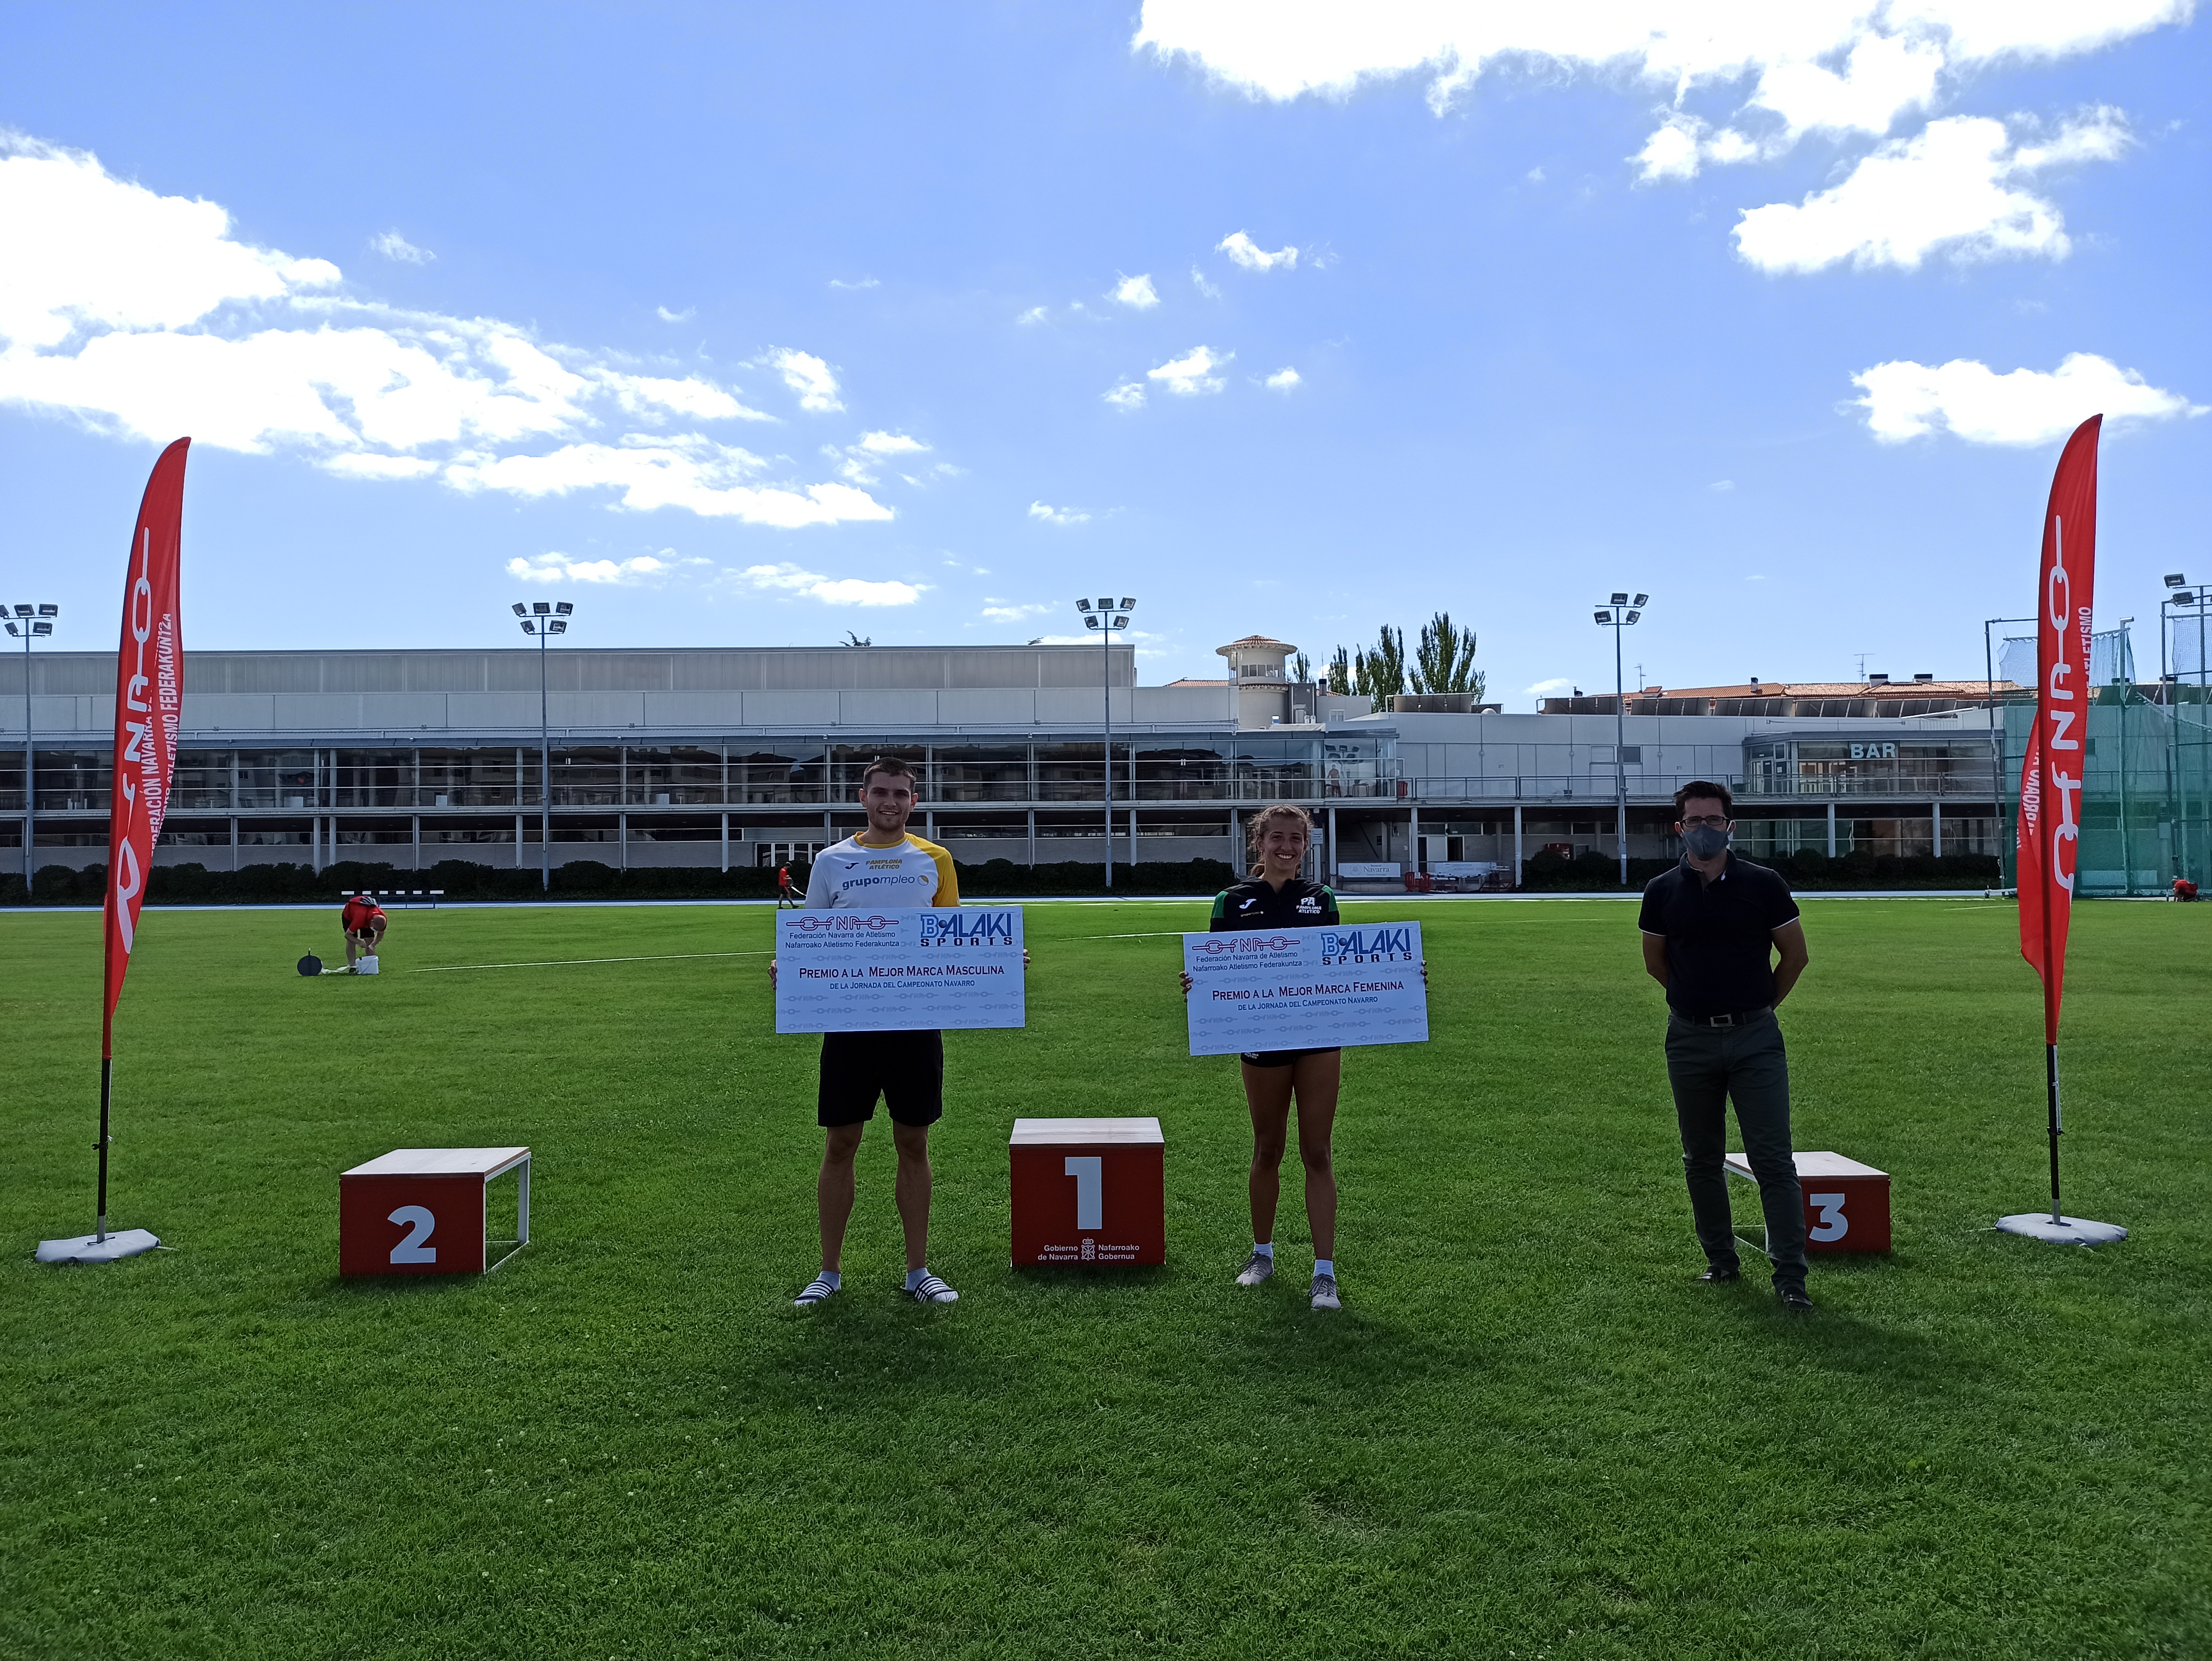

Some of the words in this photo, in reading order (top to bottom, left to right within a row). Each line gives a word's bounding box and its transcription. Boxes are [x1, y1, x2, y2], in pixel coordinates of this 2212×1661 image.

[1850, 743, 1896, 759] BAR
[842, 875, 915, 891] grupompleo
[1301, 897, 1316, 906] PA
[921, 913, 1011, 938] BALAKI
[920, 937, 1012, 947] SPORTS
[1321, 928, 1411, 957] BALAKI
[1233, 952, 1258, 961] Navarra
[1322, 952, 1412, 965] SPORTS
[799, 968, 839, 979] PREMIO
[841, 968, 849, 978] A
[851, 968, 863, 977] LA
[869, 966, 904, 977] MEJOR
[907, 965, 943, 976] MARCA
[946, 965, 1005, 975] MASCULINA
[1193, 964, 1228, 972] Nafarroako
[1260, 960, 1302, 968] Federakuntza
[1212, 990, 1250, 1001] PREMIO
[1253, 990, 1260, 998] A
[1262, 989, 1274, 998] LA
[1279, 986, 1312, 997] MEJOR
[1315, 984, 1351, 995] MARCA
[1353, 981, 1404, 992] FEMENINA
[1302, 998, 1347, 1007] CAMPEONATO
[1065, 1156, 1102, 1229] 1
[1809, 1193, 1848, 1242] 3
[387, 1205, 436, 1264] 2
